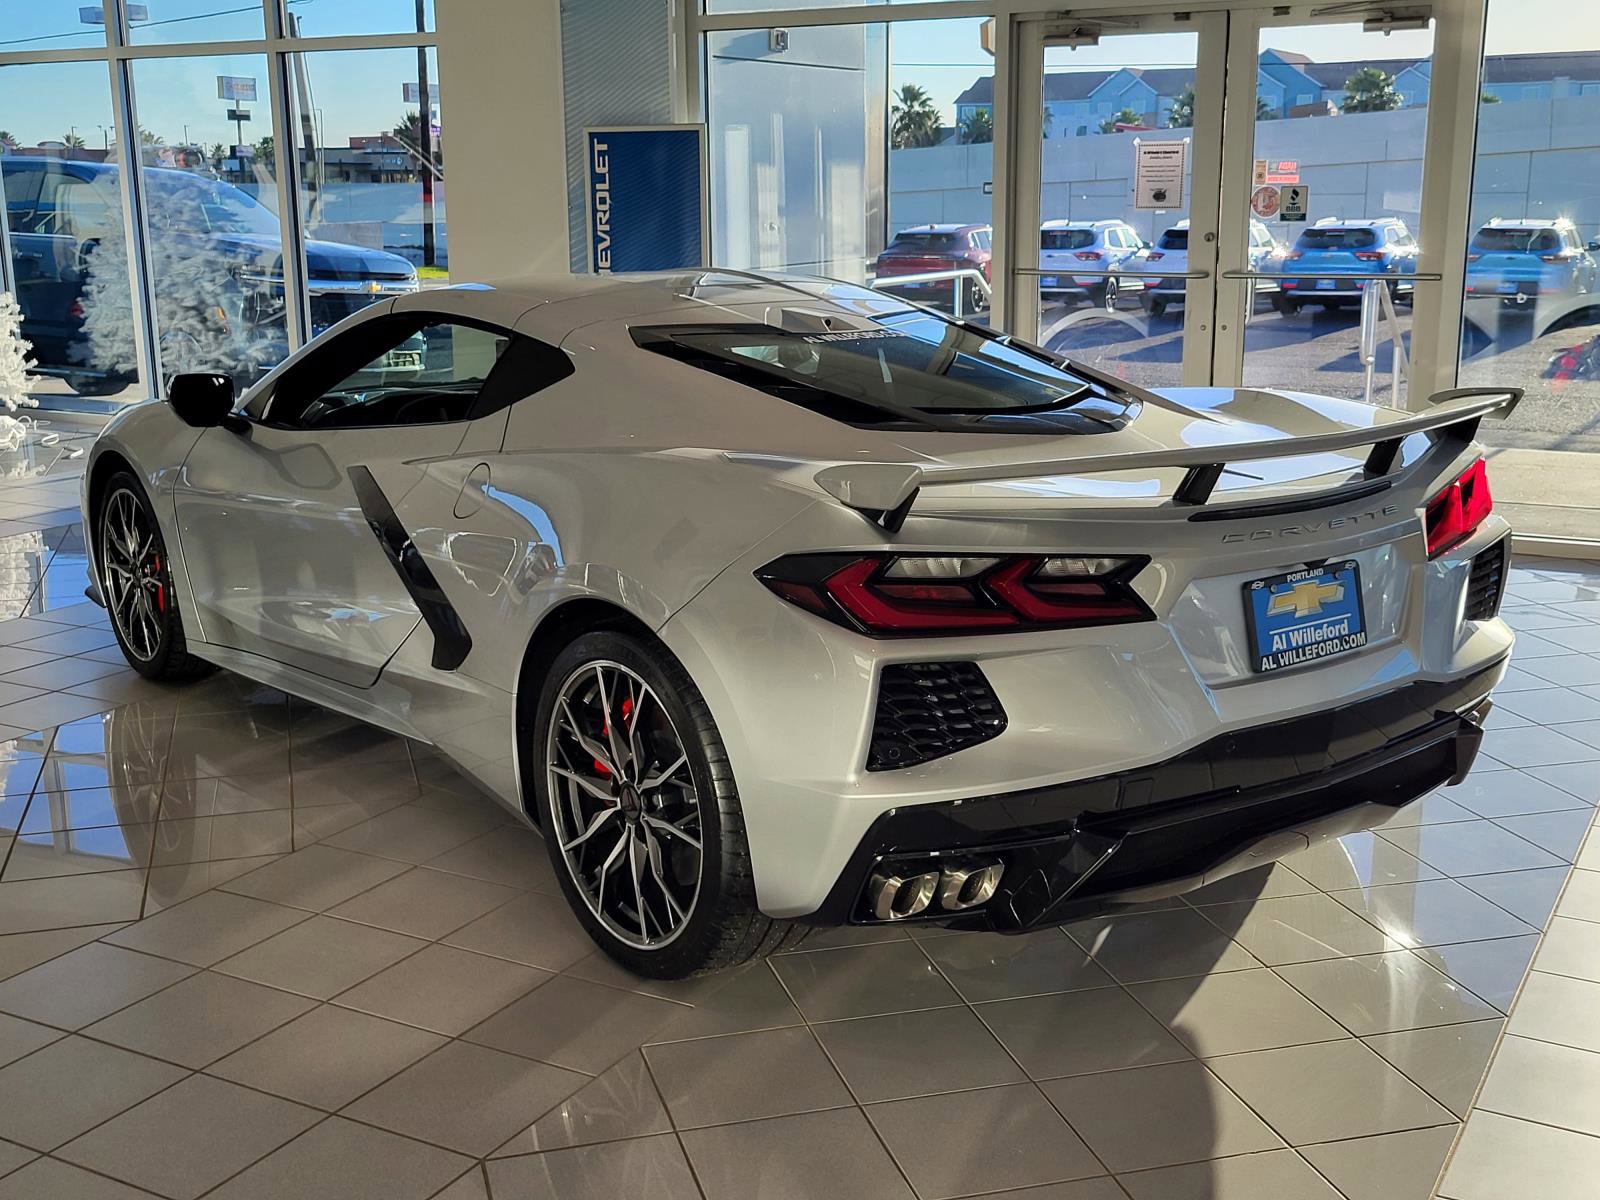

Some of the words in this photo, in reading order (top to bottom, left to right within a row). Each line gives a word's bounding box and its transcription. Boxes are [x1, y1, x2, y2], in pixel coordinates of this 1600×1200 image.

[1222, 505, 1398, 544] CORVETTE
[1287, 568, 1324, 583] PORTLAND
[1261, 654, 1277, 671] AL
[1278, 632, 1366, 663] WILLEFORD.COM
[1272, 632, 1287, 651] Al
[1289, 619, 1349, 645] Willeford
